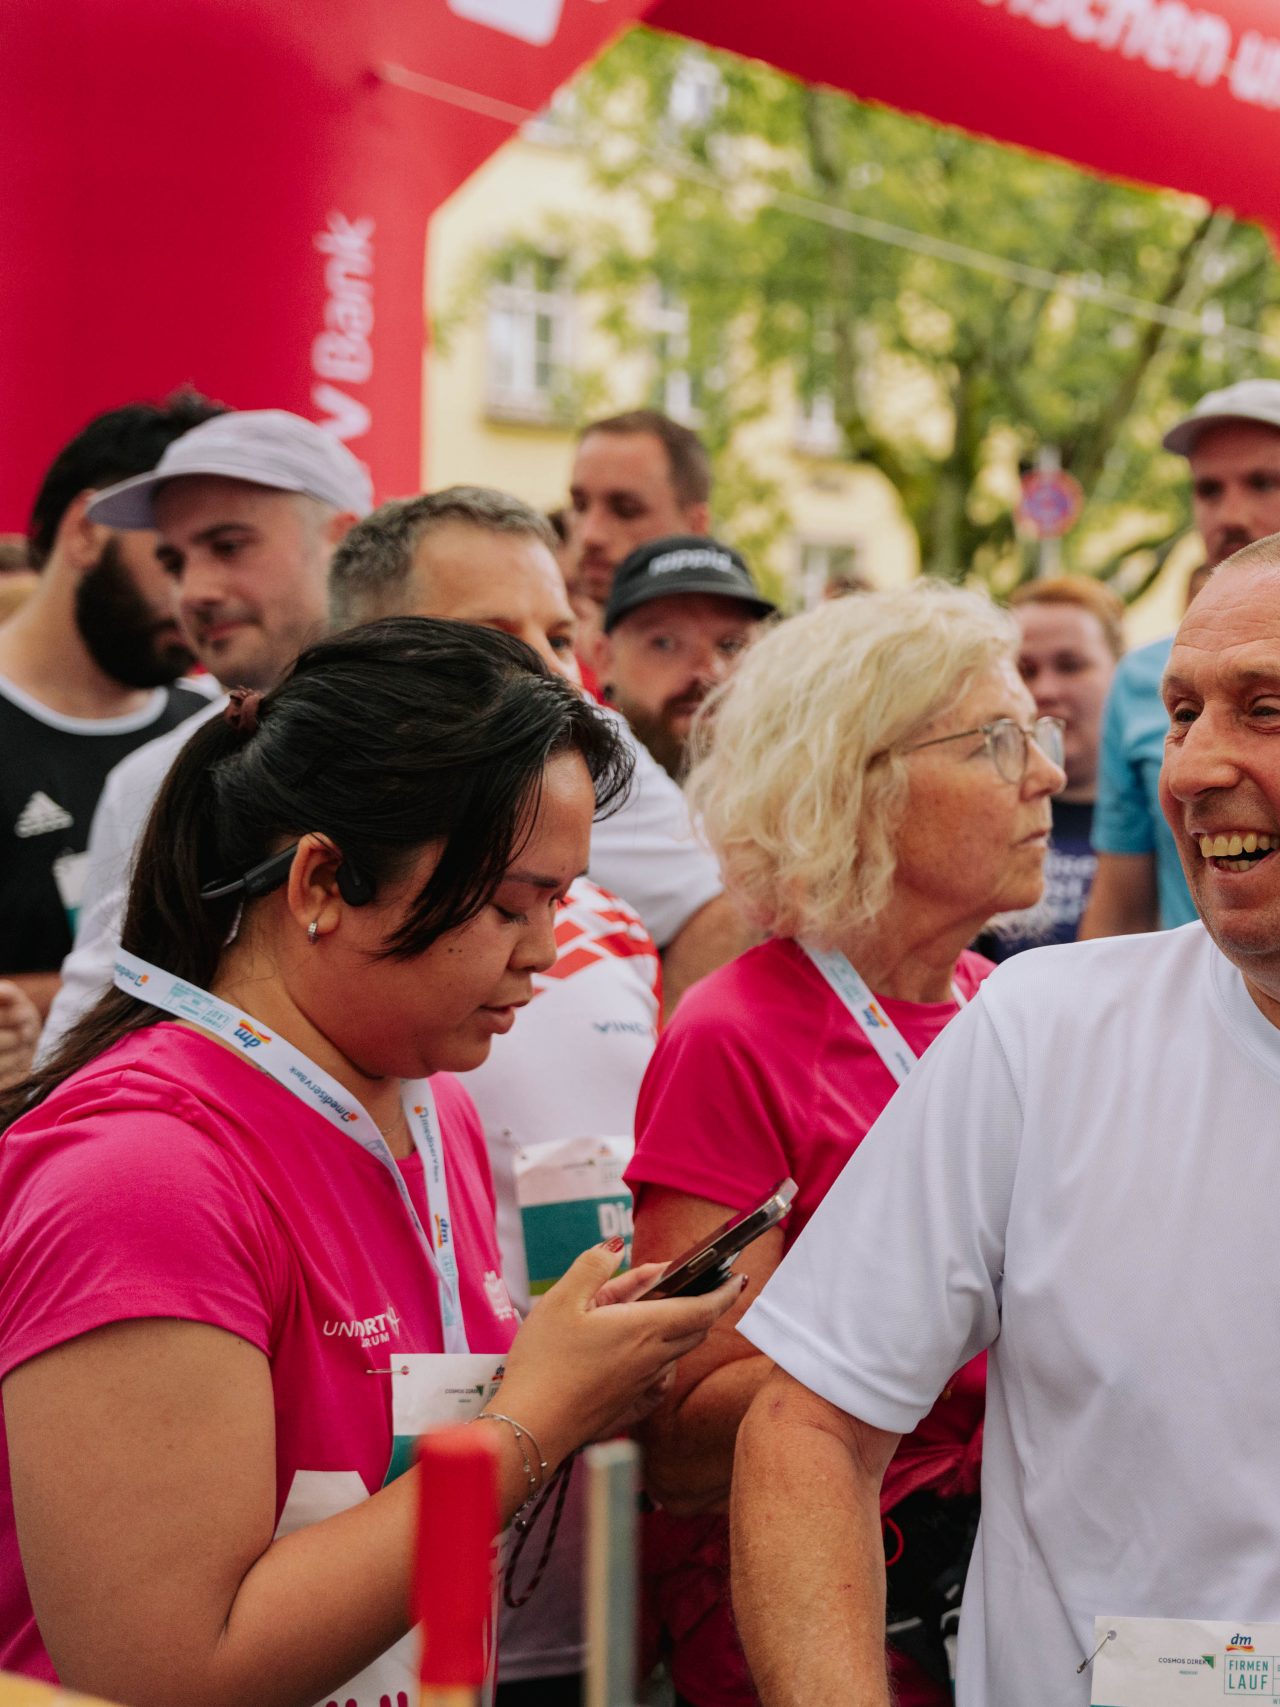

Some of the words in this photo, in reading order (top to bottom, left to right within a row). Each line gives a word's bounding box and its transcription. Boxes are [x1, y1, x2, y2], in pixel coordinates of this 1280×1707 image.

[312, 209, 375, 384] Bank
[233, 1027, 262, 1049] dm
[361, 1332, 390, 1348] RUM
[1230, 1633, 1252, 1645] dm
[1158, 1657, 1186, 1665] COSMOS
[1229, 1660, 1269, 1671] FIRMEN
[1228, 1674, 1268, 1690] LAUF
